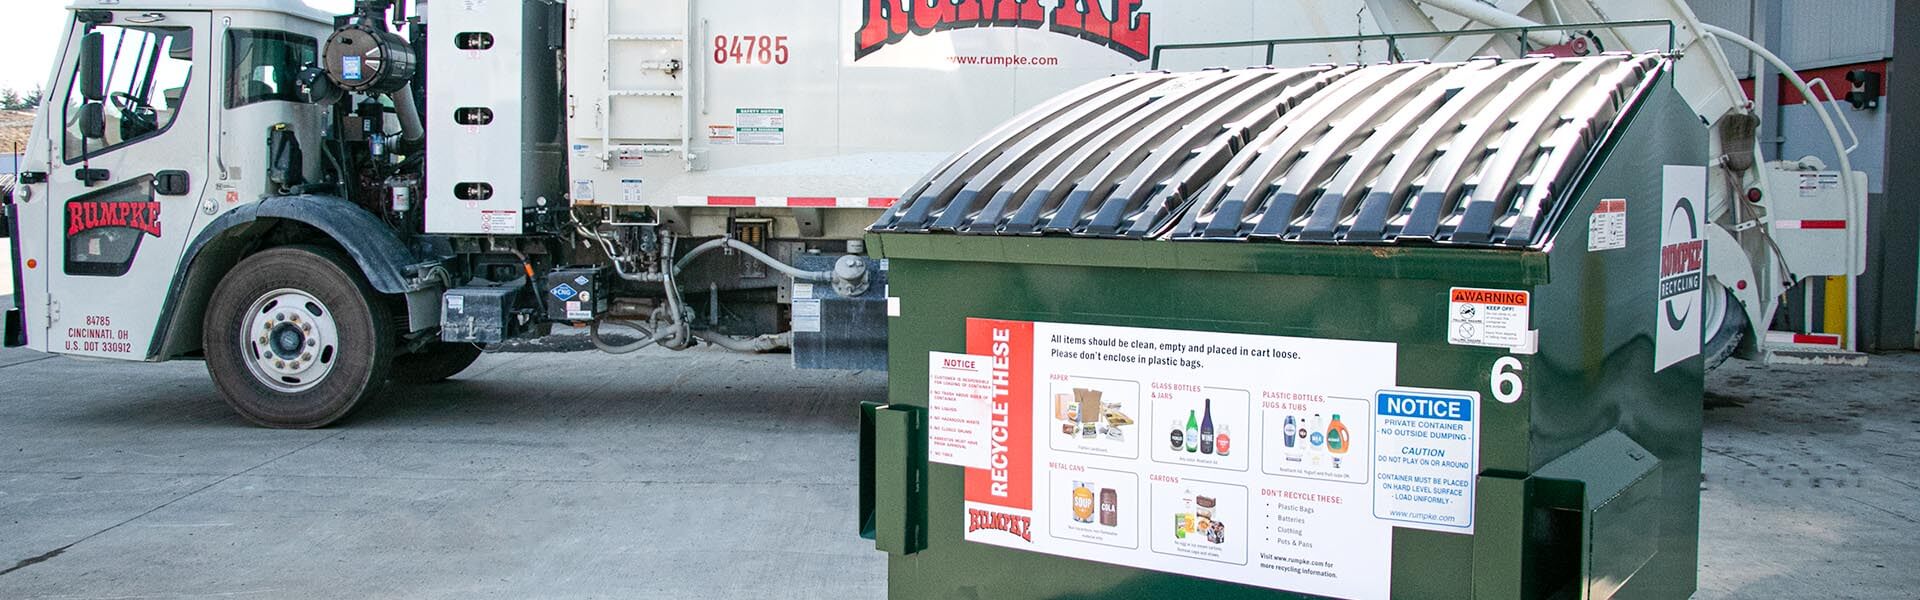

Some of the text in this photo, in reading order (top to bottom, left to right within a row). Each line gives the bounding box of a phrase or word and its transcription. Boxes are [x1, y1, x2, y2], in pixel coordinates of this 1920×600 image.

[713, 35, 789, 65] 84785
[944, 56, 1058, 69] www.rumpke.com
[68, 201, 162, 238] RUMPKE
[1661, 240, 1702, 278] RUMPKE
[1662, 275, 1699, 296] RECYCLING
[1464, 292, 1524, 304] WARNING
[86, 316, 110, 326] 84785
[65, 340, 132, 353] U.S. DOT 330912
[1051, 334, 1302, 360] All items should be clean, empty and placed in cart loose.
[944, 358, 976, 369] NOTICE
[1051, 348, 1204, 369] Please don't enclose in plastic bags.
[1050, 374, 1068, 382] PAPER
[1491, 356, 1522, 403] 6
[1151, 382, 1201, 392] GLASS BOTTLES
[1262, 391, 1326, 403] PLASTIC BOTTLES,
[992, 328, 1010, 498] RECYCLE THESE
[1289, 403, 1307, 411] TUBS
[1387, 398, 1461, 418] NOTICE
[1384, 419, 1464, 430] PRIVATE CONTAINER
[1395, 429, 1429, 438] OUTSIDE
[1430, 432, 1466, 440] DUMPING
[1402, 446, 1445, 458] CAUTION
[1049, 462, 1085, 472] METAL CANS
[1403, 457, 1418, 465] PLAY
[1442, 460, 1469, 469] AROUND
[1150, 474, 1179, 484] CARTONS
[1378, 473, 1413, 482] CONTAINER
[1443, 478, 1469, 487] PLACED
[1261, 488, 1343, 504] DON'T RECYCLE THESE:
[1412, 485, 1432, 494] LEVEL
[1433, 487, 1462, 496] SURFACE
[1074, 496, 1092, 508] SOUP
[1414, 495, 1449, 504] UNIFORMLY
[1102, 503, 1116, 512] COLA
[1278, 503, 1314, 514] Plastic Bags
[1278, 515, 1305, 524] Batteries
[1390, 511, 1455, 522] www.rumpke.com
[969, 508, 1032, 543] RUMPKE
[1278, 526, 1302, 536] Clothing
[1274, 555, 1324, 568] www.rumpke.com
[1276, 565, 1301, 574] recycling
[1302, 568, 1337, 578] information.
